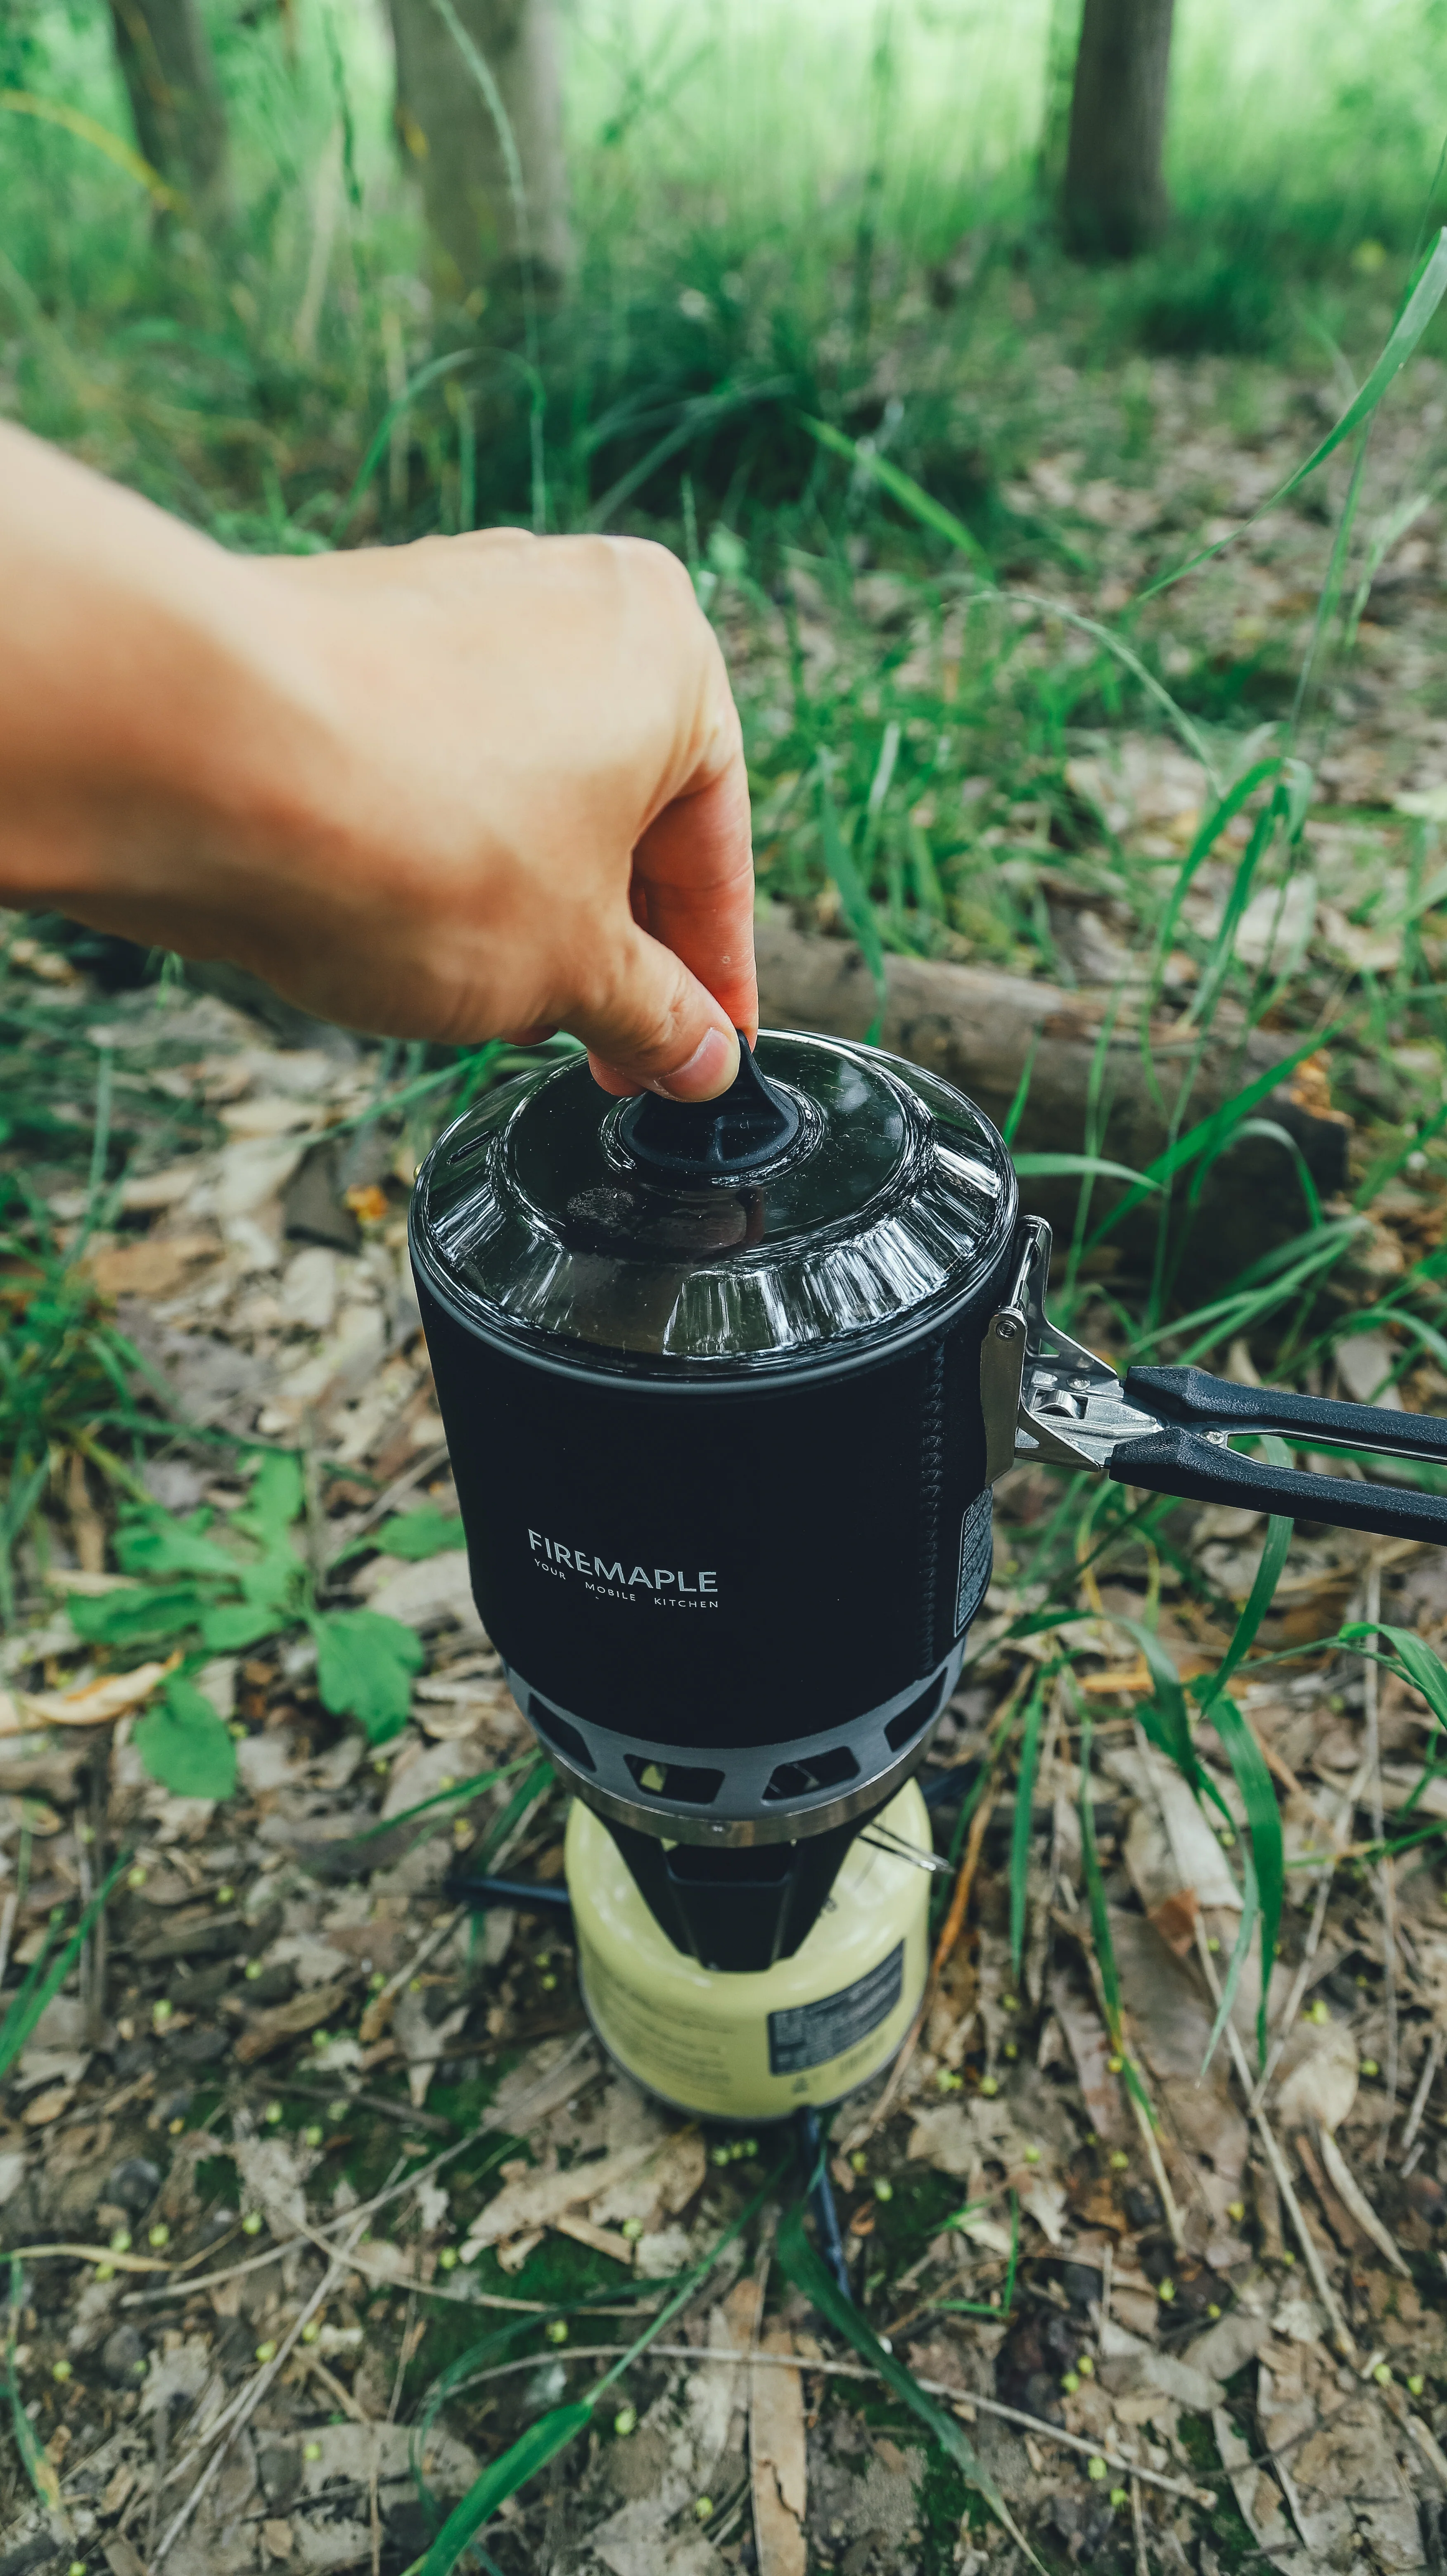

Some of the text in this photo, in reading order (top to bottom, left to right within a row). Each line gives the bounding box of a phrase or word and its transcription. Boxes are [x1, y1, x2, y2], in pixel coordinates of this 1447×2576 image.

[528, 1529, 718, 1592] FIREMAPLE
[534, 1558, 718, 1608] YOUR MOBILE KITCHEN
